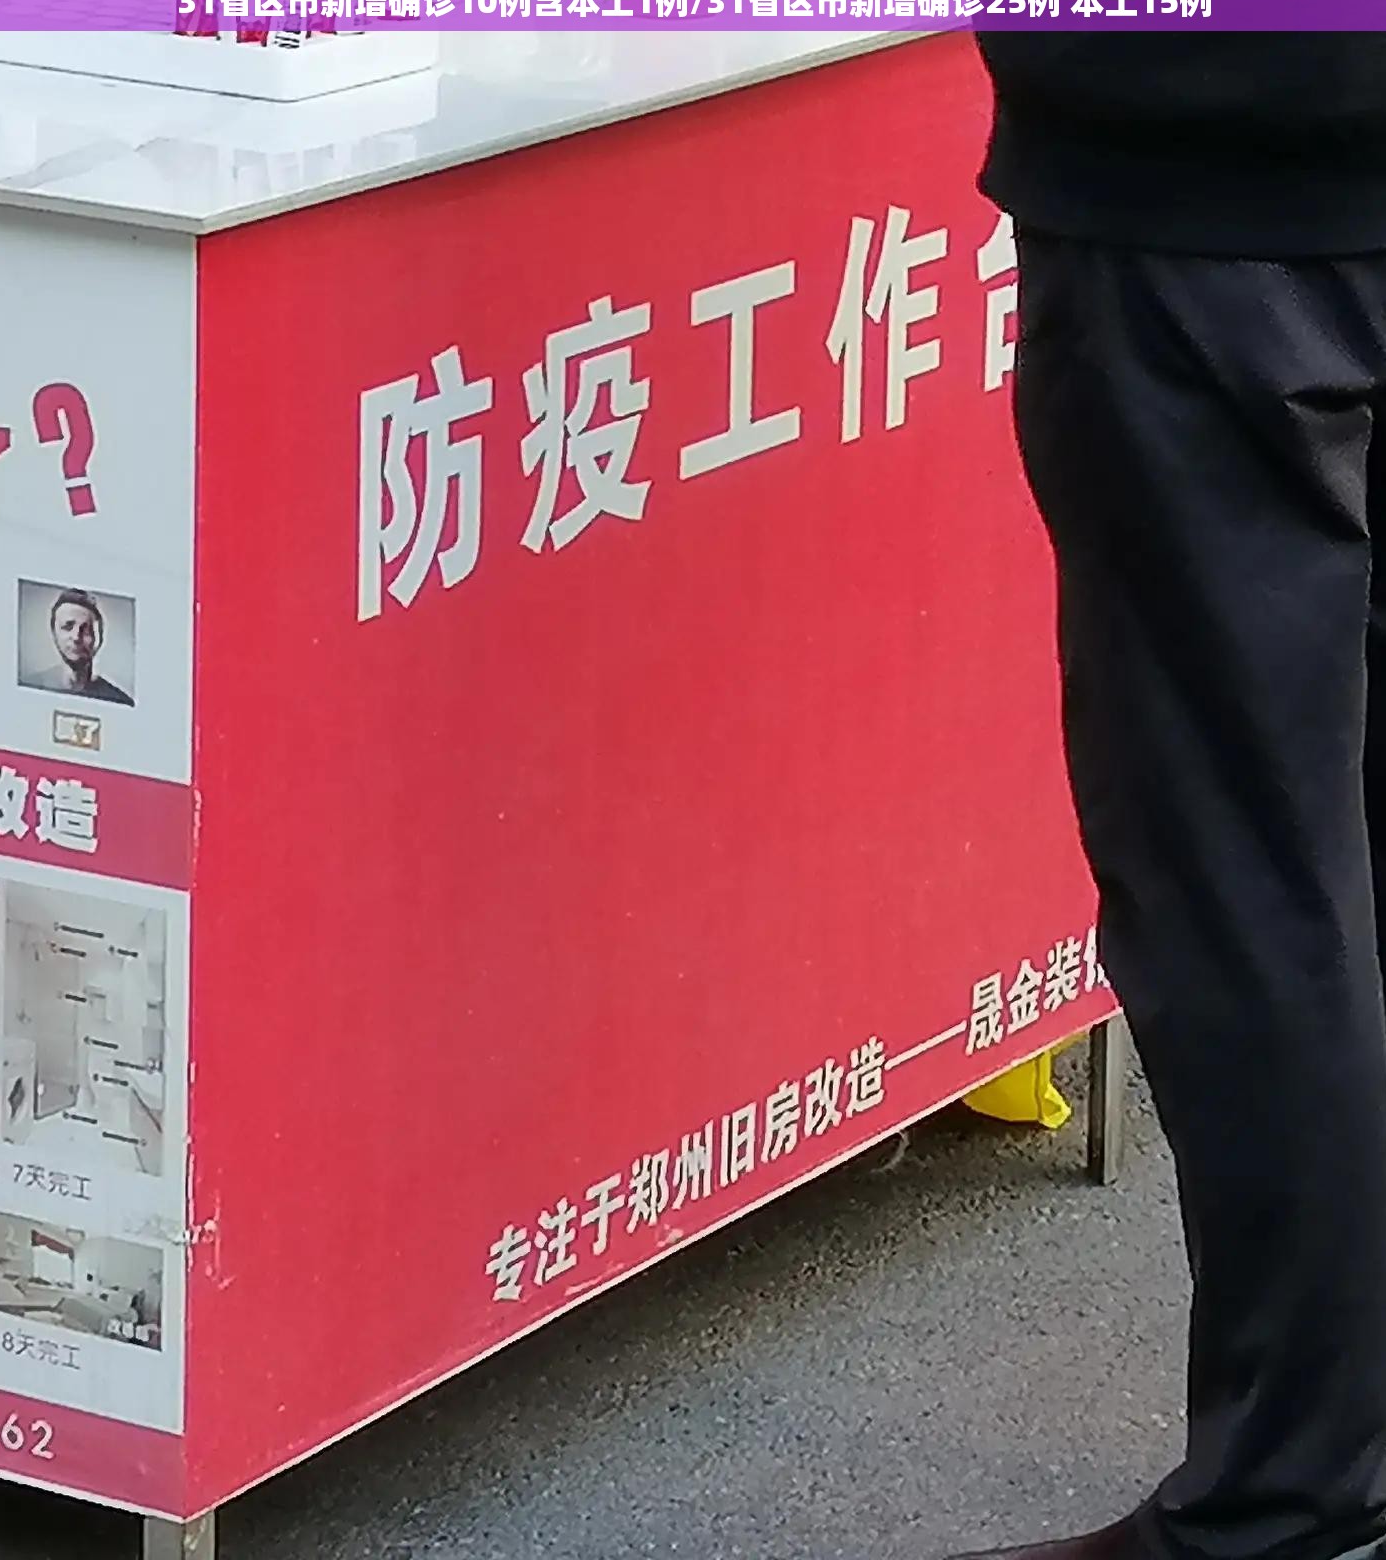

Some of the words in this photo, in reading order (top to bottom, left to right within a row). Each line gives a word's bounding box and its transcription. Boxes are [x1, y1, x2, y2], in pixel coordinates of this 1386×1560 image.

[13, 1162, 93, 1201] 7天完工
[1, 1328, 81, 1371] 8天完工
